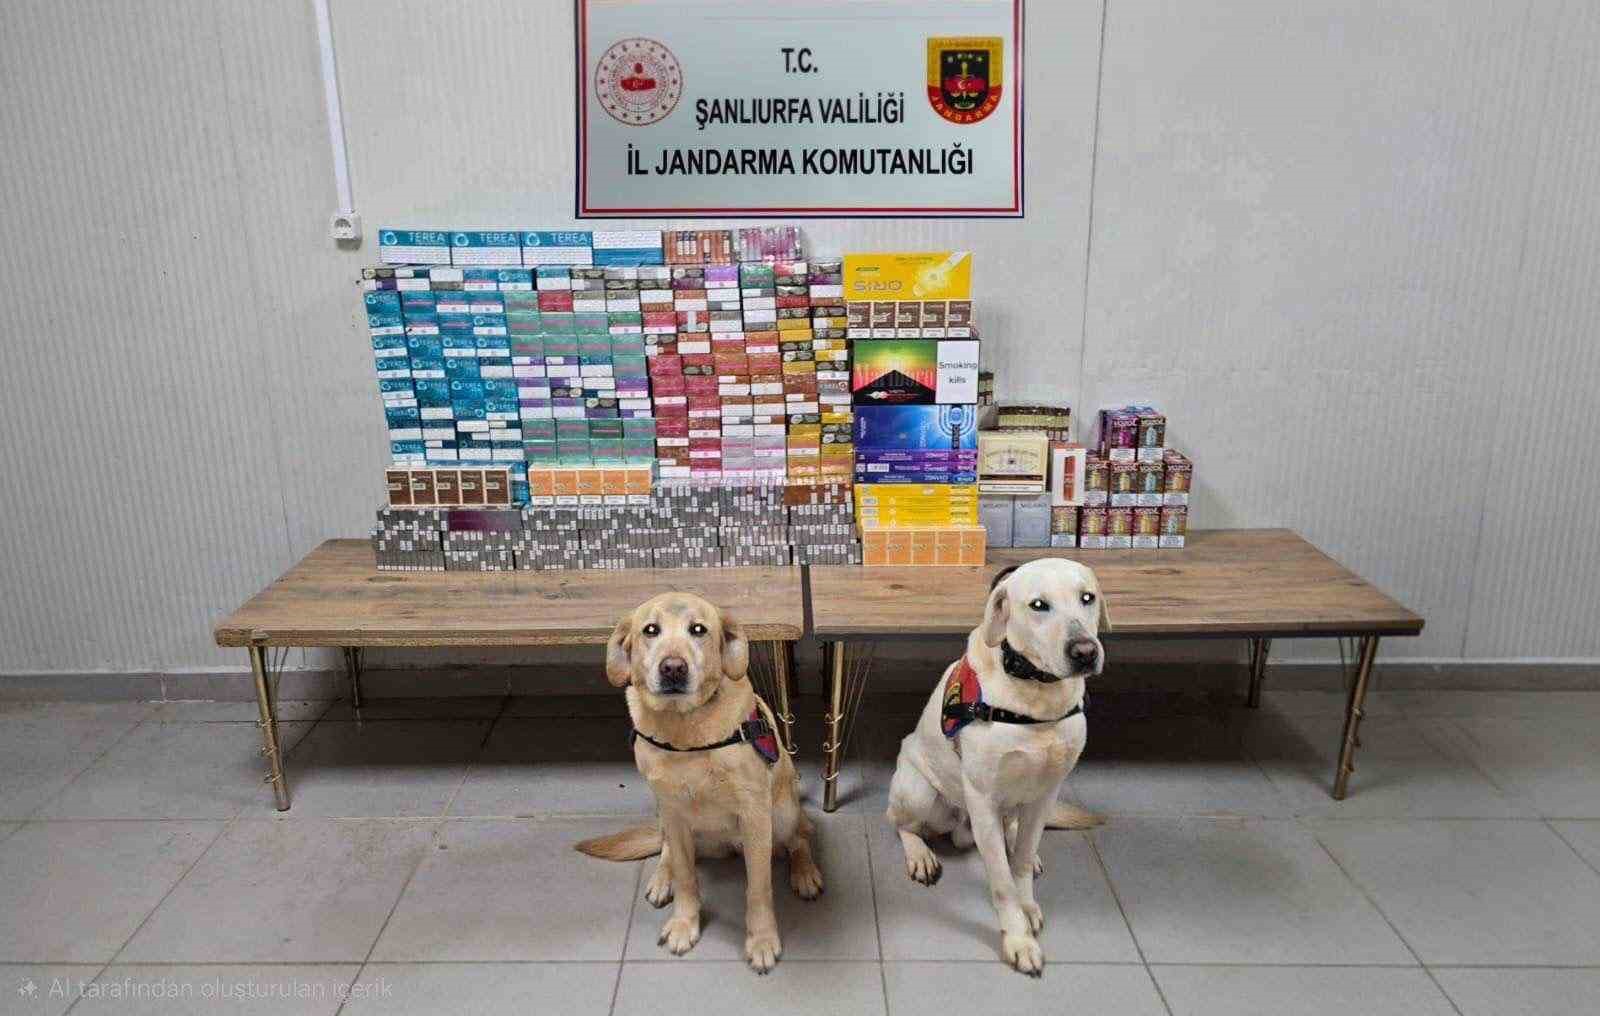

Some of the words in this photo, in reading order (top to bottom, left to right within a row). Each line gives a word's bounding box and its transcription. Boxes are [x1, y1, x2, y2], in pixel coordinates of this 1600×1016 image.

[781, 47, 818, 74] T.C.
[695, 98, 814, 130] ŞANLIURFA
[819, 92, 905, 124] VALİLİĞİ
[627, 143, 649, 175] İL
[655, 148, 796, 175] JANDARMA
[802, 143, 974, 175] KOMUTANLIĞI
[408, 232, 445, 242] TEREA
[480, 233, 516, 243] TEREA
[551, 233, 586, 243] TEREA
[939, 361, 978, 371] Smoking
[949, 376, 967, 384] kills
